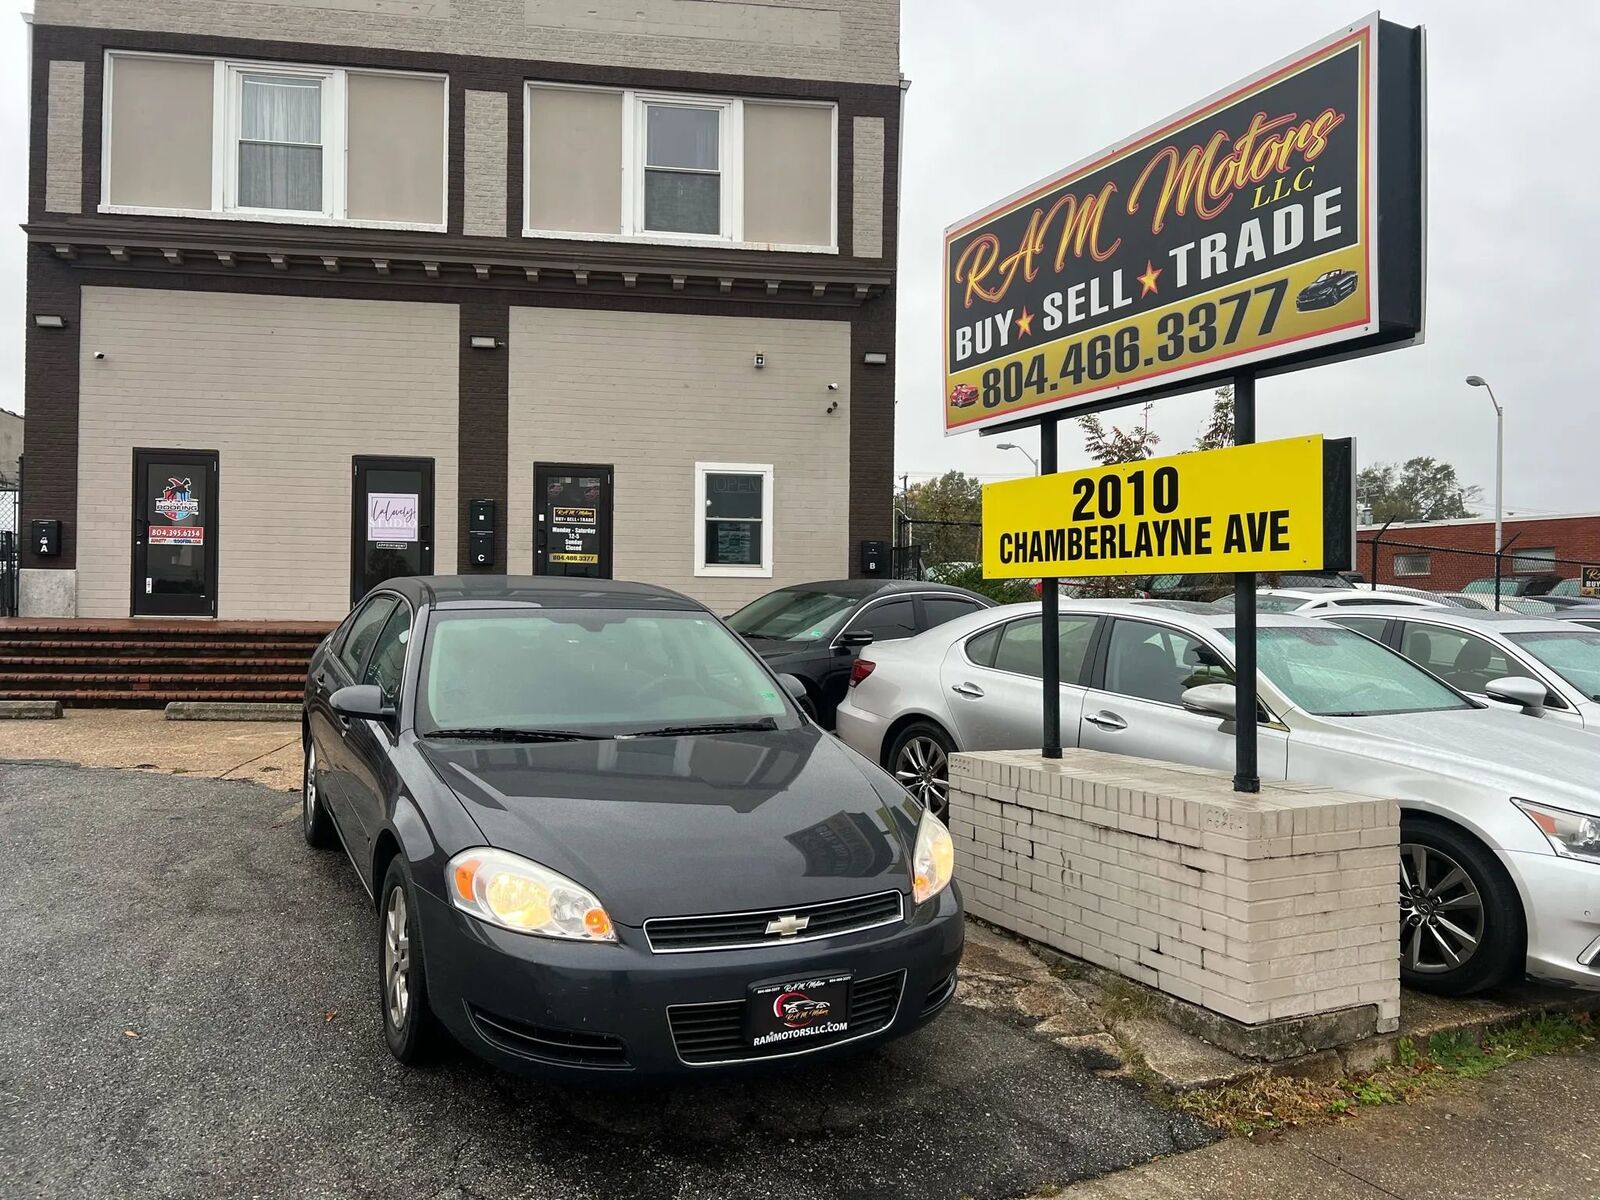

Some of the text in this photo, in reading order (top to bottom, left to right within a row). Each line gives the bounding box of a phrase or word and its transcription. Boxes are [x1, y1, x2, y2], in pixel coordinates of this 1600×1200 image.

[954, 107, 1345, 309] RAM Motors
[1250, 165, 1316, 210] LLC
[954, 186, 1342, 361] BUY SELL TRADE
[982, 279, 1290, 408] 804.466.3377
[1072, 466, 1179, 522] 2010
[40, 544, 48, 553] A
[478, 554, 485, 562] C
[999, 510, 1290, 564] CHAMBERLAYNE AVE
[869, 562, 876, 570] B
[753, 1022, 848, 1047] RAMMOTORSLLC.COM
